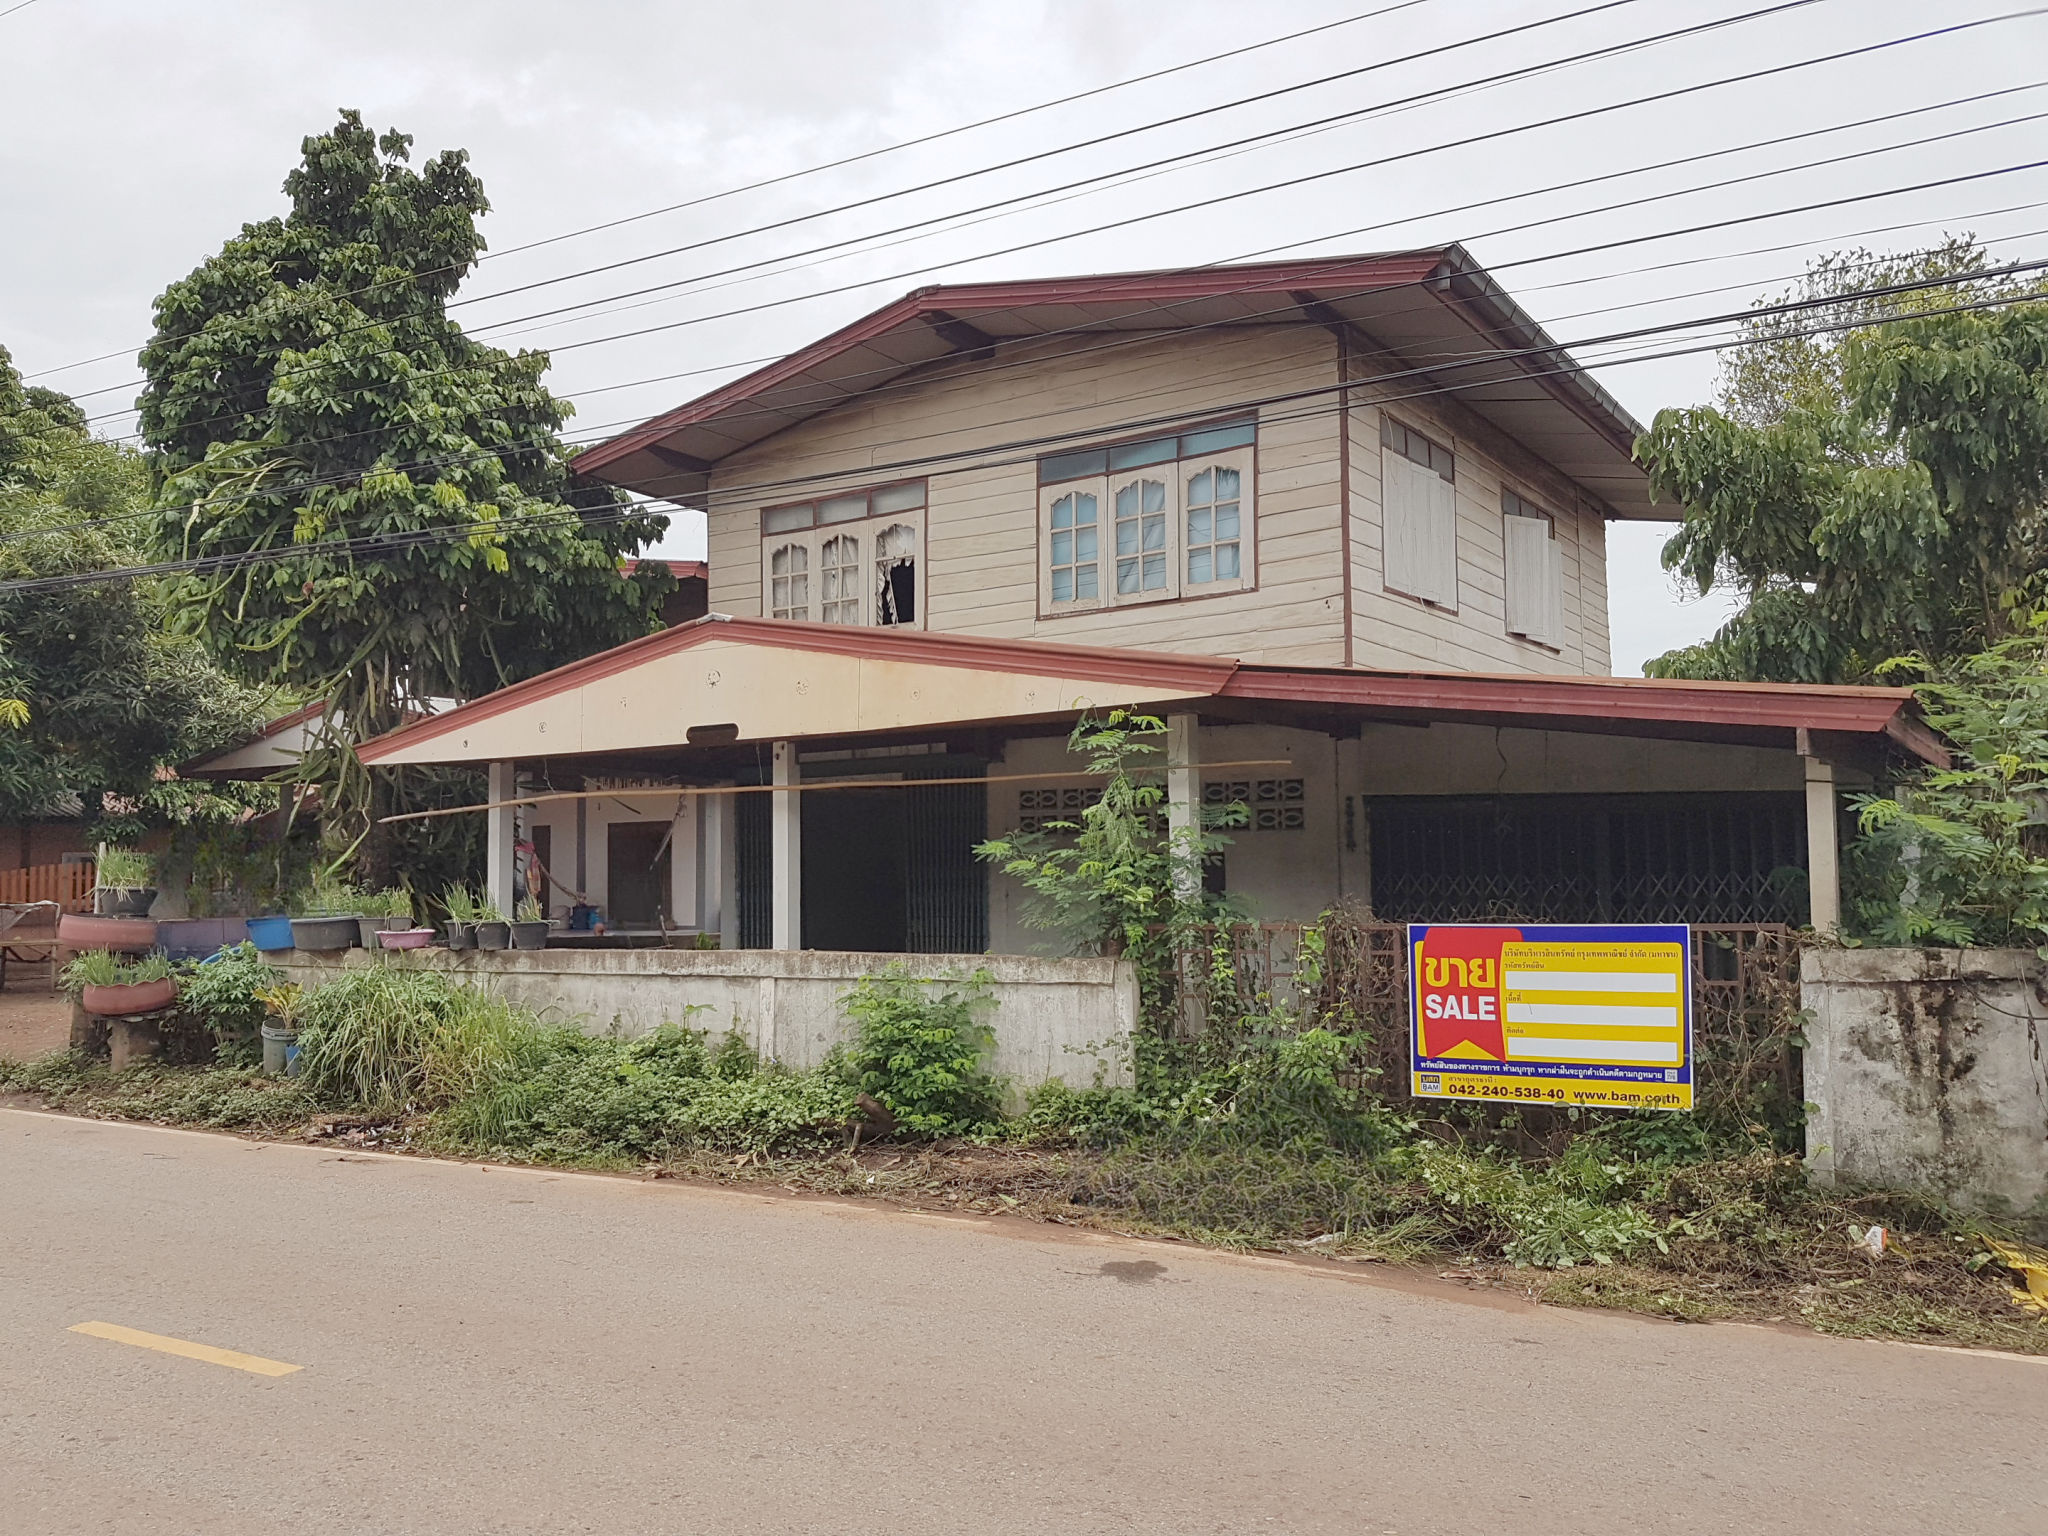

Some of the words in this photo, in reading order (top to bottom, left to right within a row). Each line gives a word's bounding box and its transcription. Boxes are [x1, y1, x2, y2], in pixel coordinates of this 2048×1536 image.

[1425, 957, 1496, 988] ขาย
[1425, 994, 1496, 1020] SALE
[1422, 1083, 1440, 1093] BAM
[1448, 1084, 1565, 1100] 042-240-538-40
[1573, 1090, 1681, 1104] www.bam.coth
